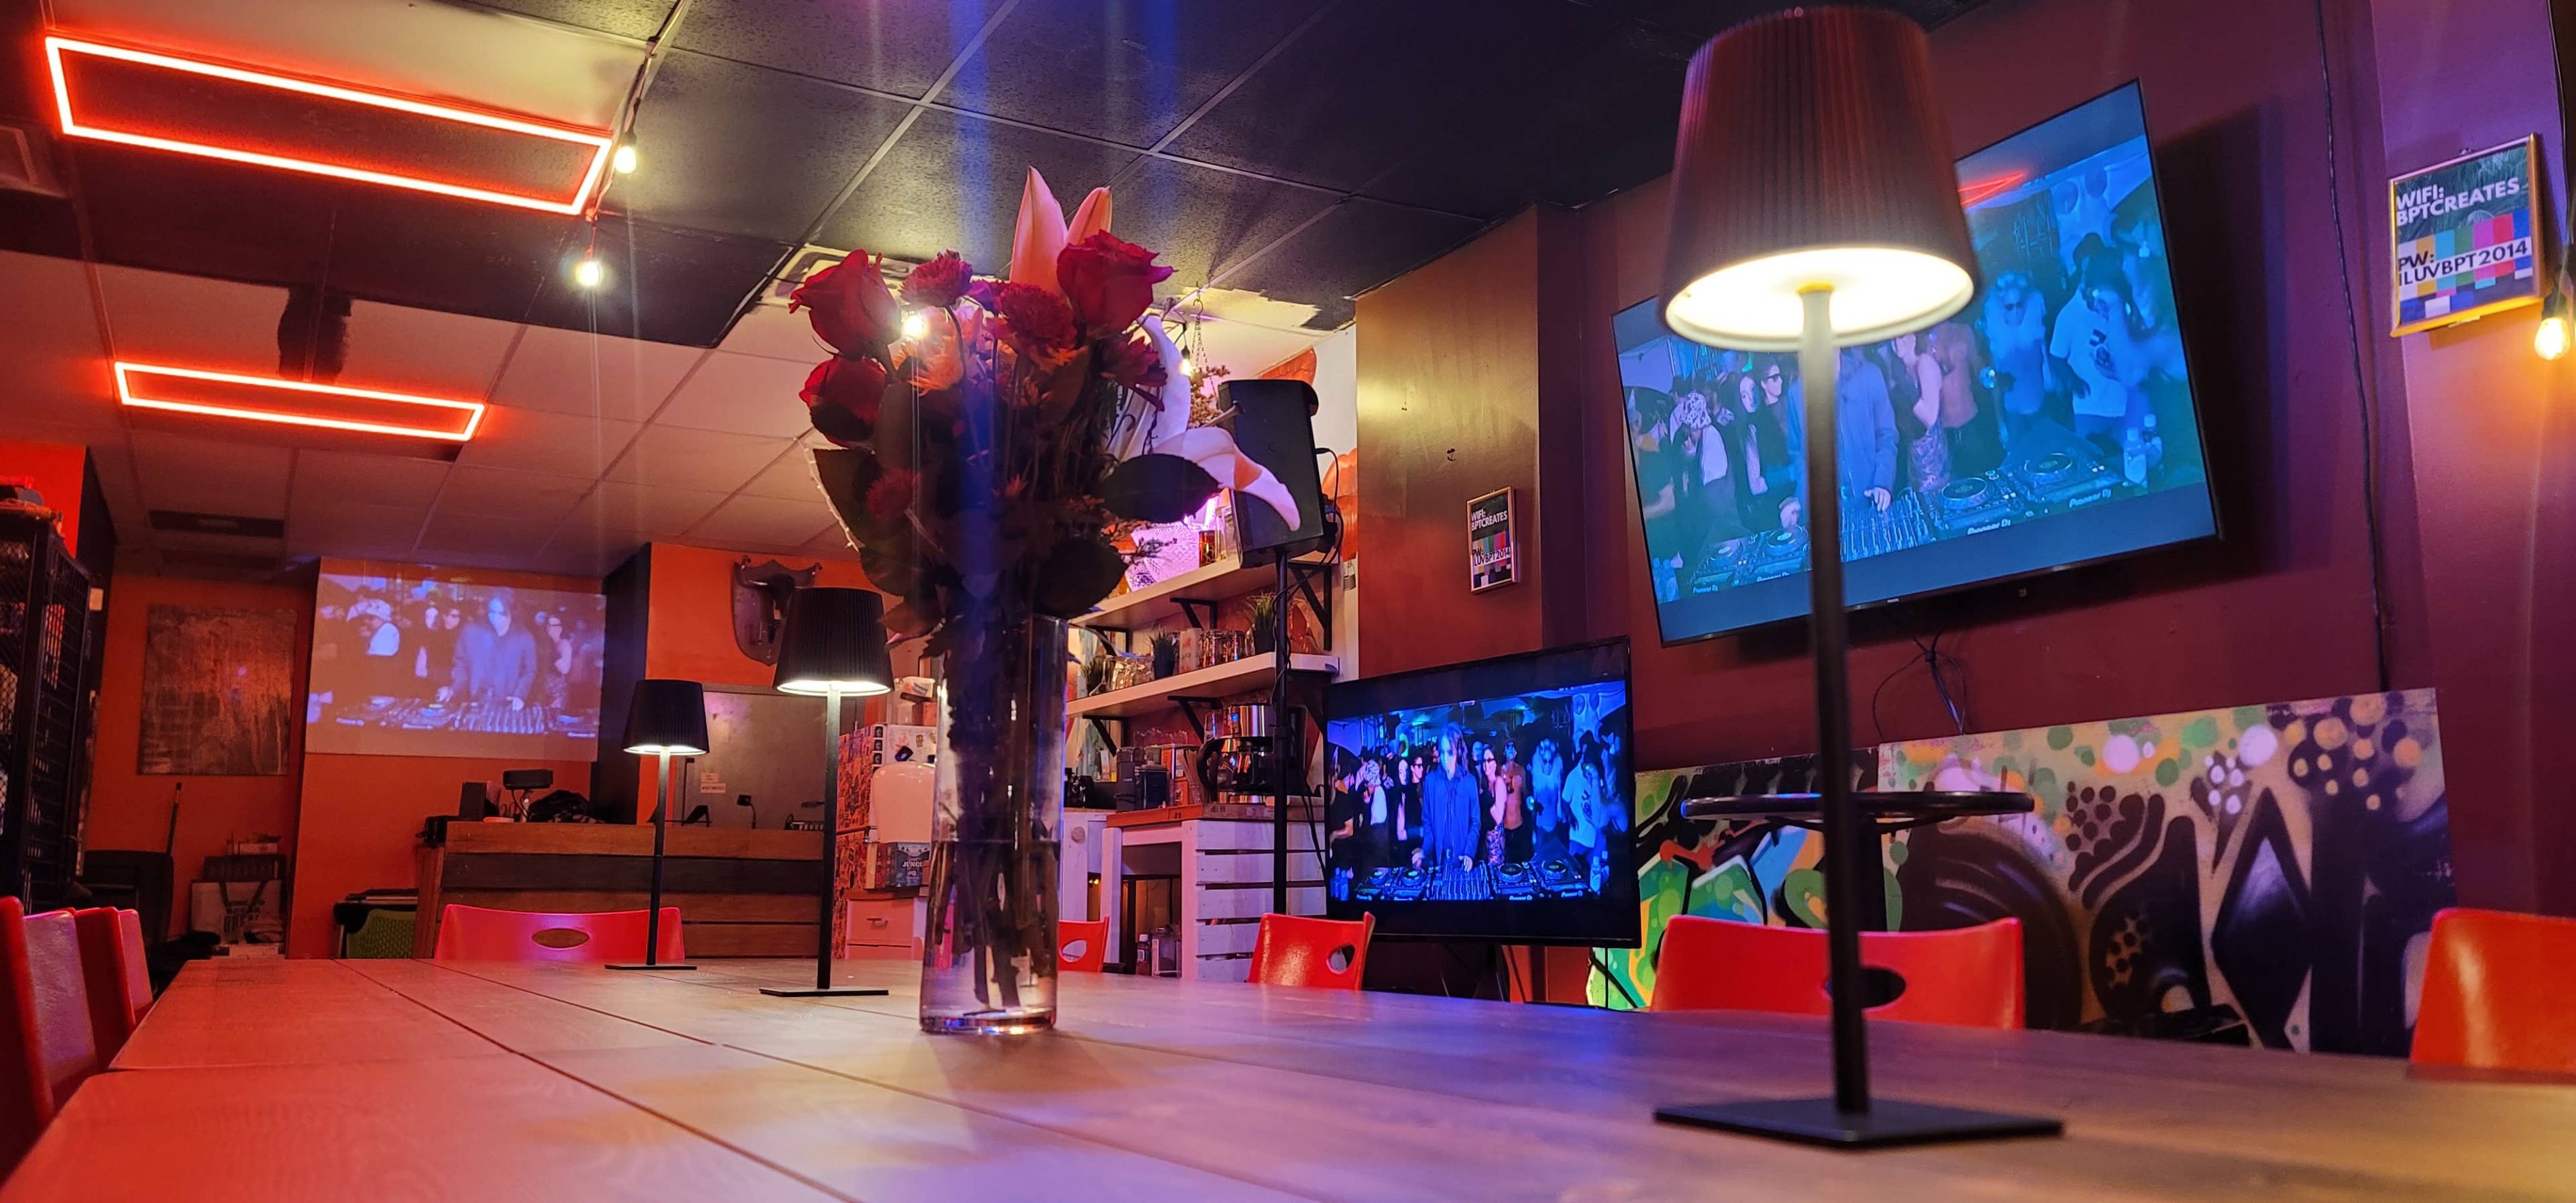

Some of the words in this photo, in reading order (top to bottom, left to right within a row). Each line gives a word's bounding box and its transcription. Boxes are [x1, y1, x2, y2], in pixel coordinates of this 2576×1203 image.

[2396, 177, 2520, 226] BPTCREATES
[2397, 184, 2445, 210] WIFI:
[2398, 250, 2434, 271] PW:
